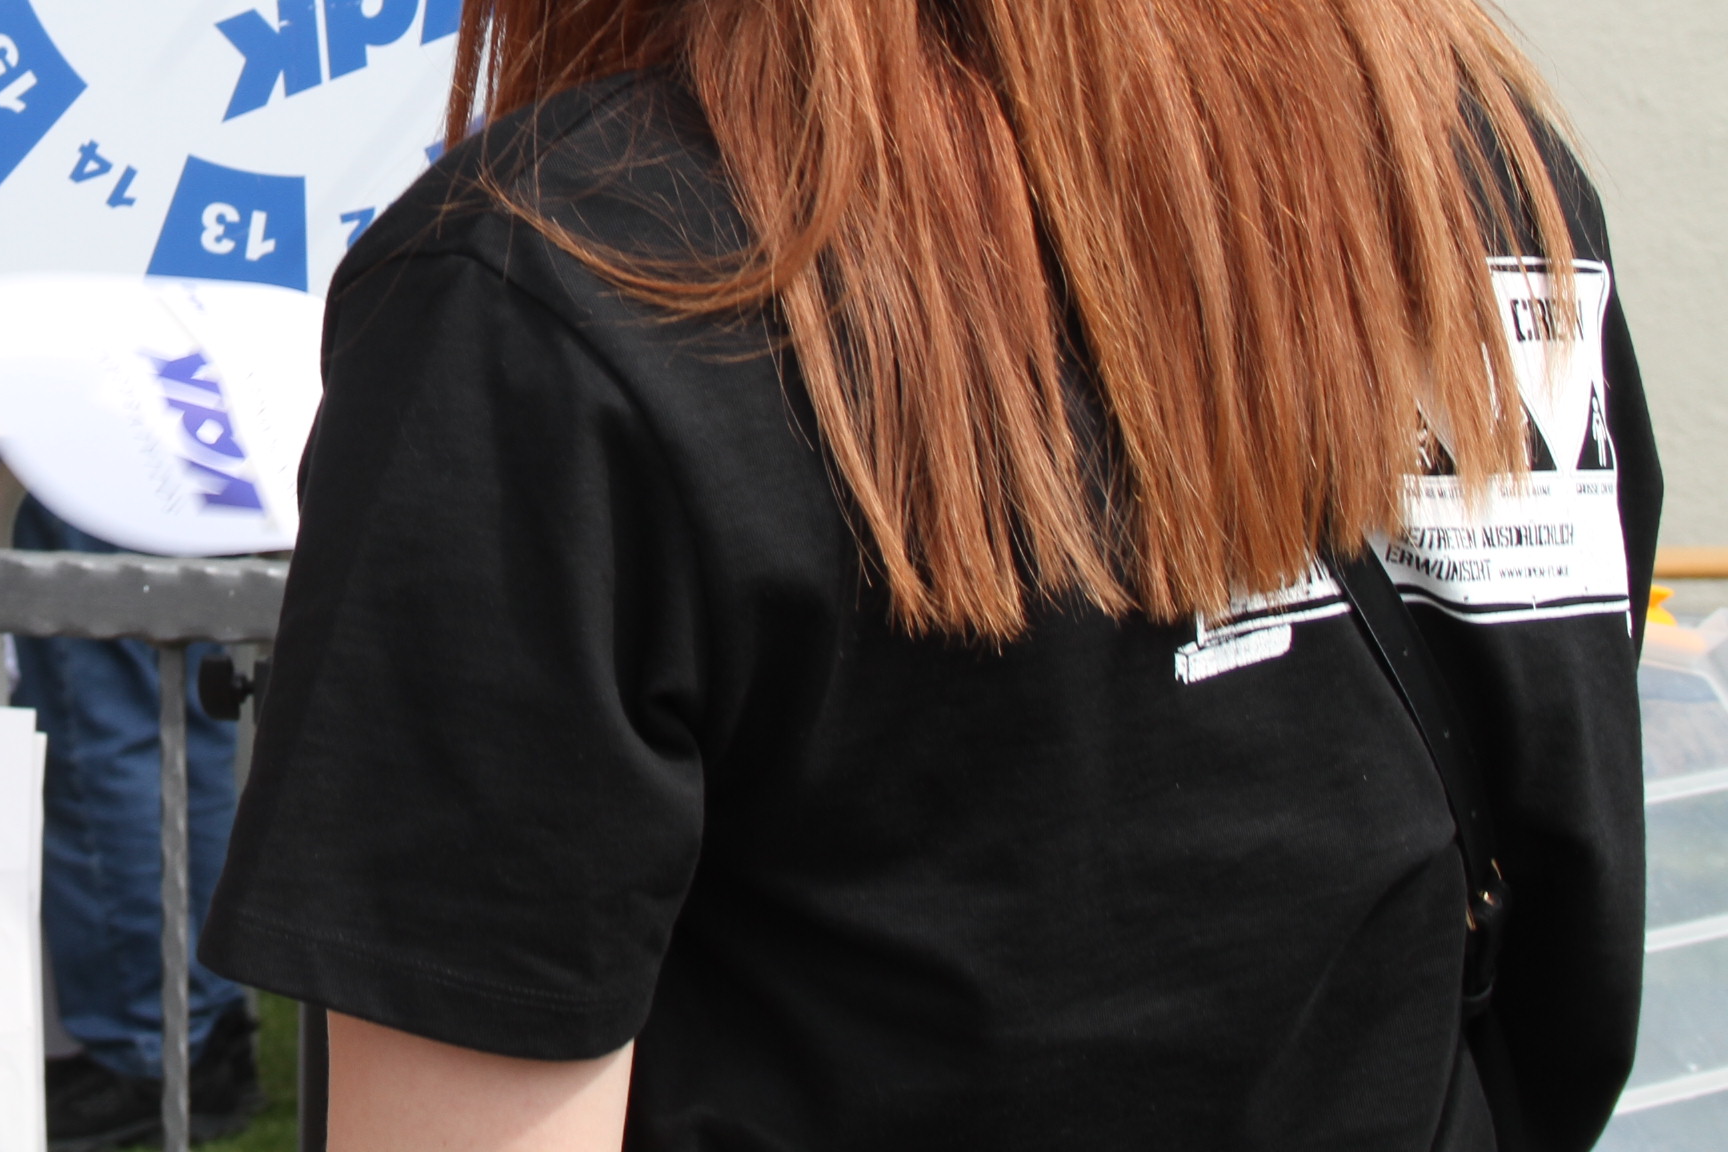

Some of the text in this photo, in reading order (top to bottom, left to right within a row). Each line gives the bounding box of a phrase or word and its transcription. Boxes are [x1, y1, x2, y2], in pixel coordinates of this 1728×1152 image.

[69, 139, 139, 210] 14
[200, 200, 276, 263] 13
[1400, 525, 1477, 550] EITRETEN
